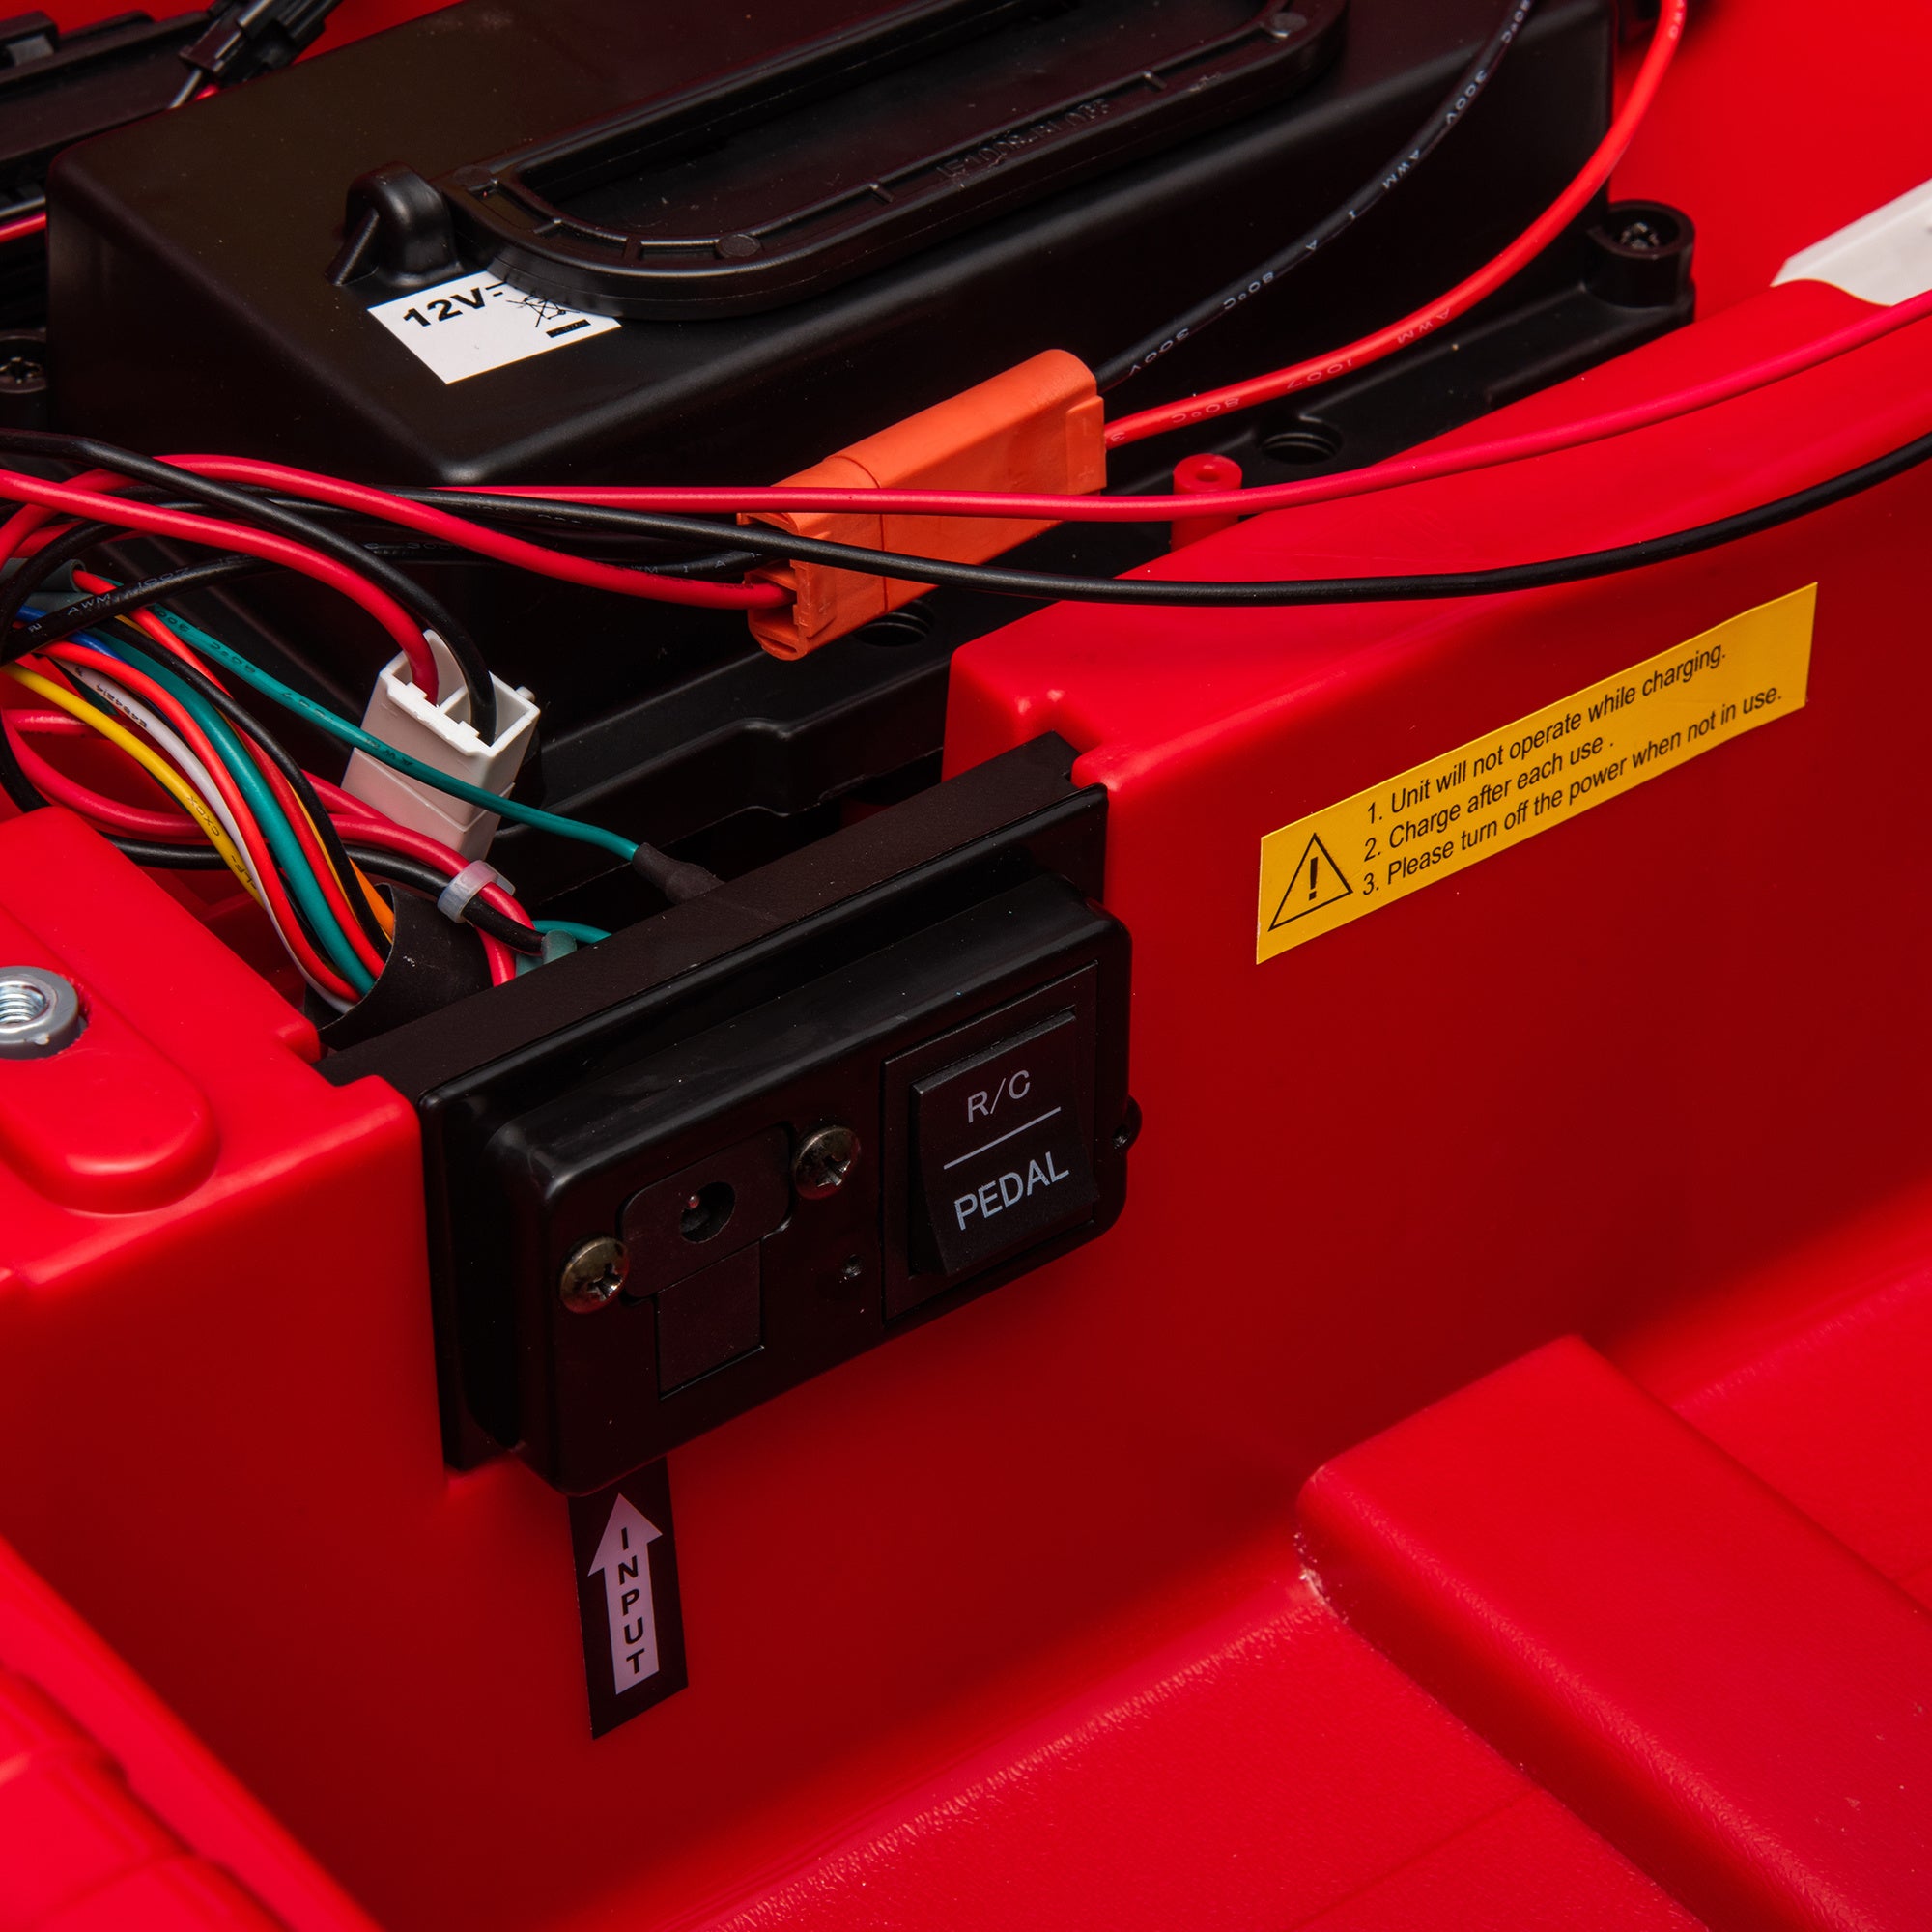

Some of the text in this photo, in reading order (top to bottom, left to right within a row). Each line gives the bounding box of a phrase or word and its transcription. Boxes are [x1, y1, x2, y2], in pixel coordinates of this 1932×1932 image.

[1446, 69, 1488, 125] 300V
[1381, 148, 1420, 190] AWM
[1129, 328, 1189, 376] 300V
[1397, 308, 1450, 344] AWM
[1287, 358, 1352, 389] 1007
[67, 592, 111, 617] AWM
[1366, 645, 1726, 824] 1. Unit will not operate while charging.
[1362, 687, 1782, 895] 3. Please turn off the power when not in use.
[1363, 837, 1381, 863] 2.
[1389, 803, 1461, 849] Charge
[1466, 779, 1512, 814] after
[1517, 753, 1563, 790] each
[966, 1069, 1031, 1123] R/C
[953, 1151, 1070, 1231] PEDAL
[617, 1526, 645, 1675] INPUT
